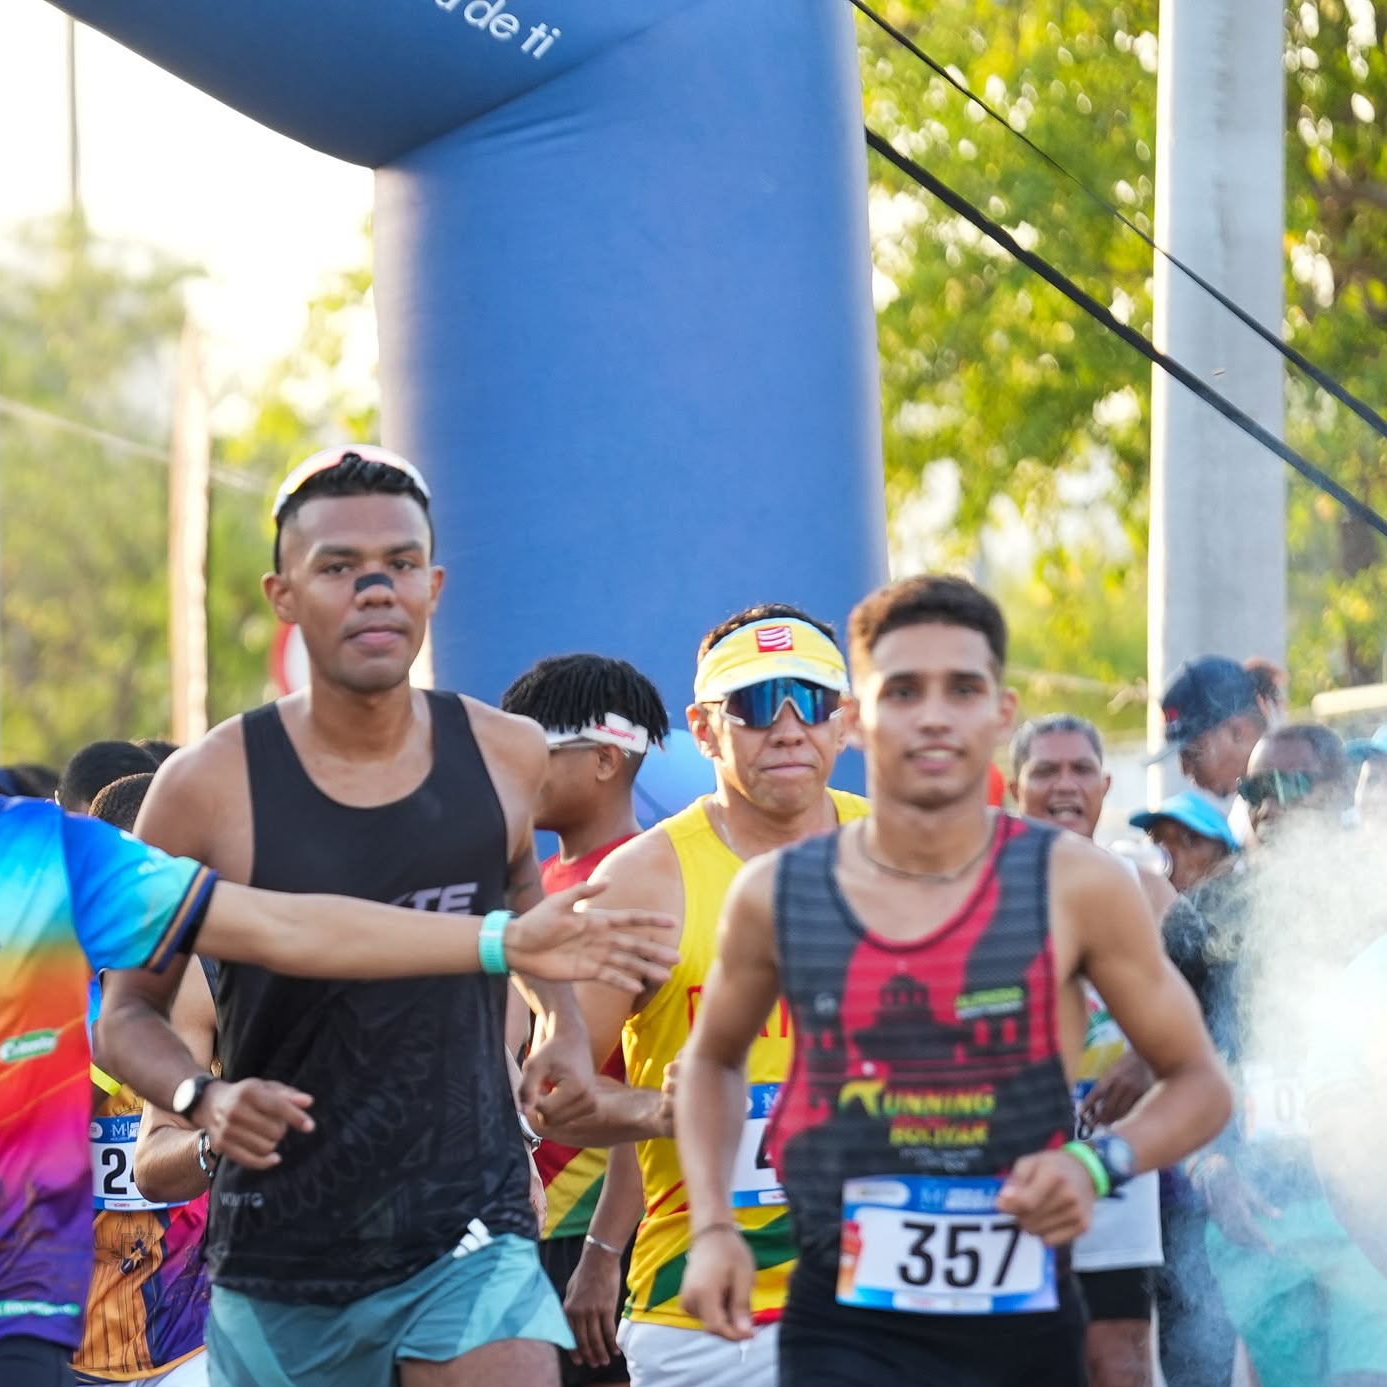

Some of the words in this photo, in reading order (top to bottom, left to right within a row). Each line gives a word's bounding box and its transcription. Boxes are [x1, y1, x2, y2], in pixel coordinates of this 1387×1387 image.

[463, 0, 520, 41] de
[521, 22, 562, 60] ti
[897, 1220, 1023, 1289] 357
